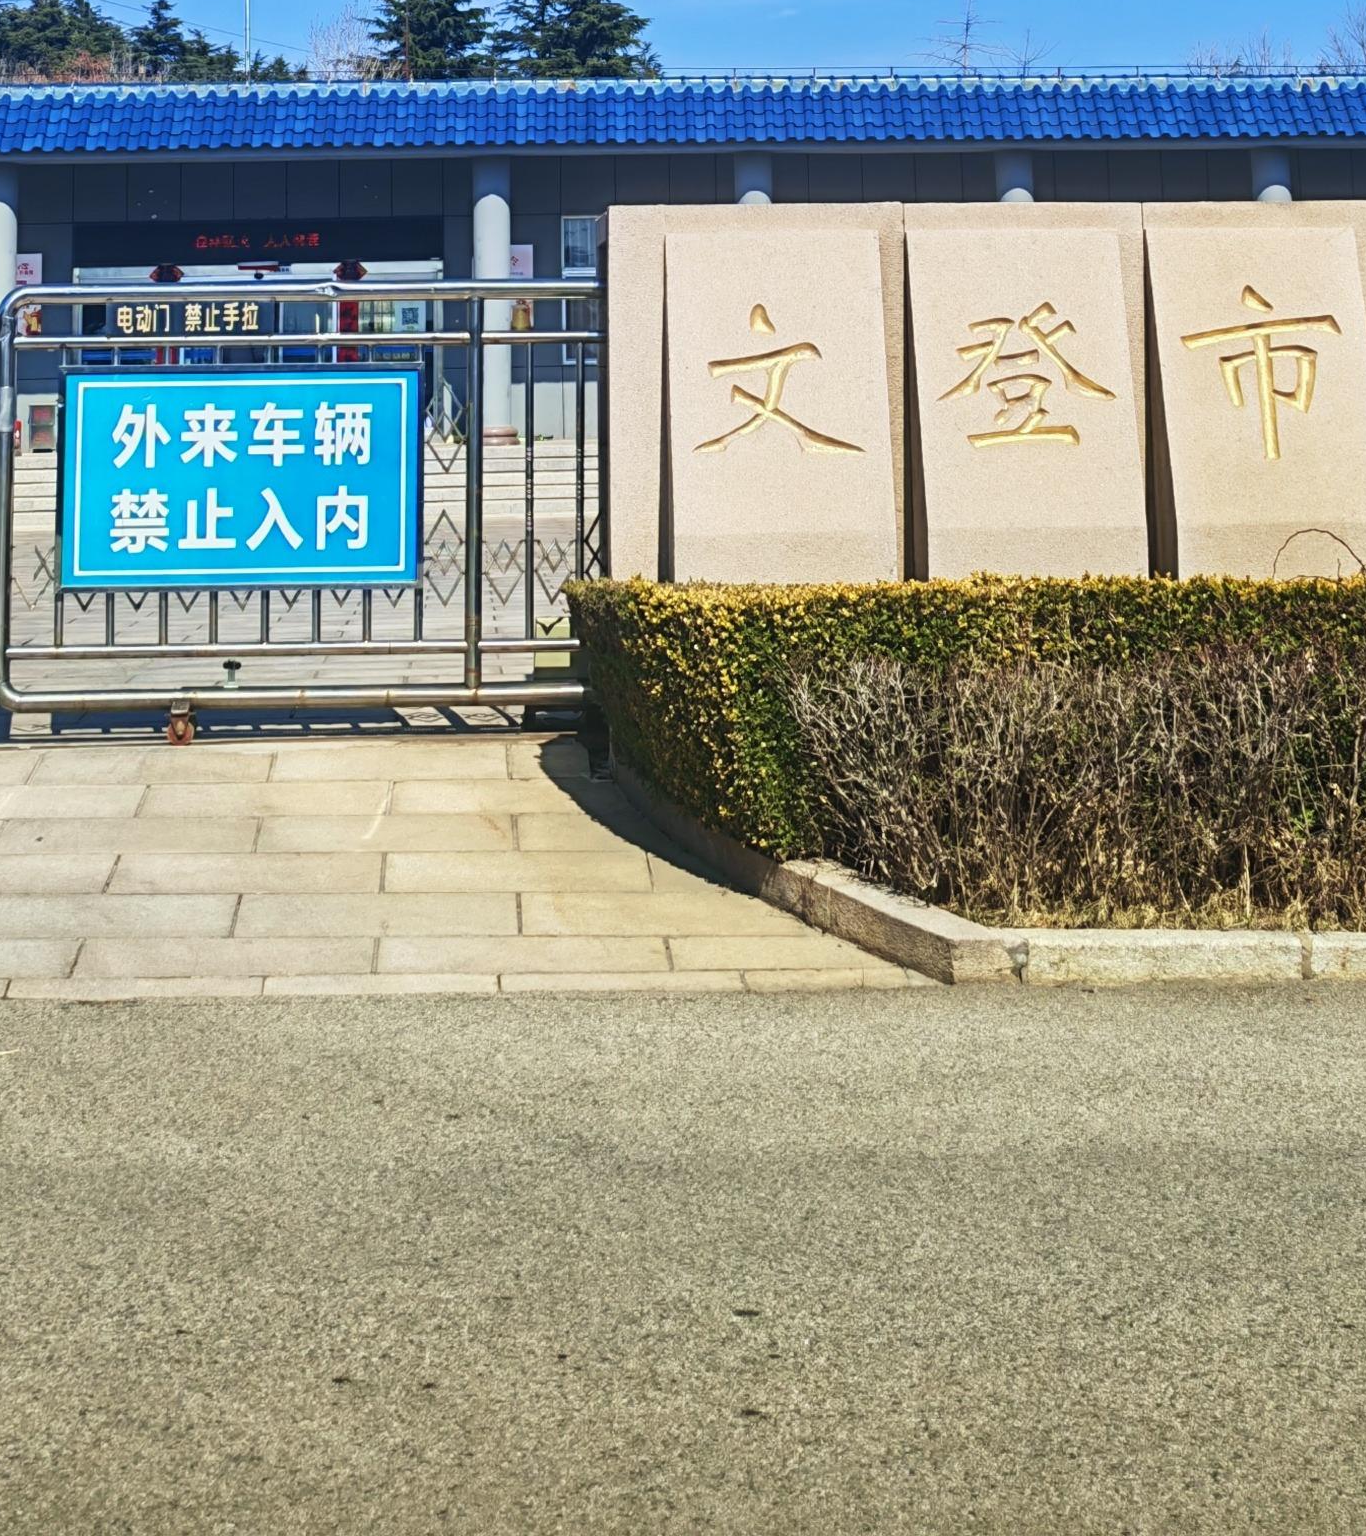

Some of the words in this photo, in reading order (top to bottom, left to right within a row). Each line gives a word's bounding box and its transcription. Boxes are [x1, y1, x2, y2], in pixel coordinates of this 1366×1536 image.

[117, 304, 170, 334] 电动门
[185, 302, 259, 332] 禁止手拉
[112, 401, 373, 469] 外来车辆
[109, 485, 369, 554] 禁止入内
